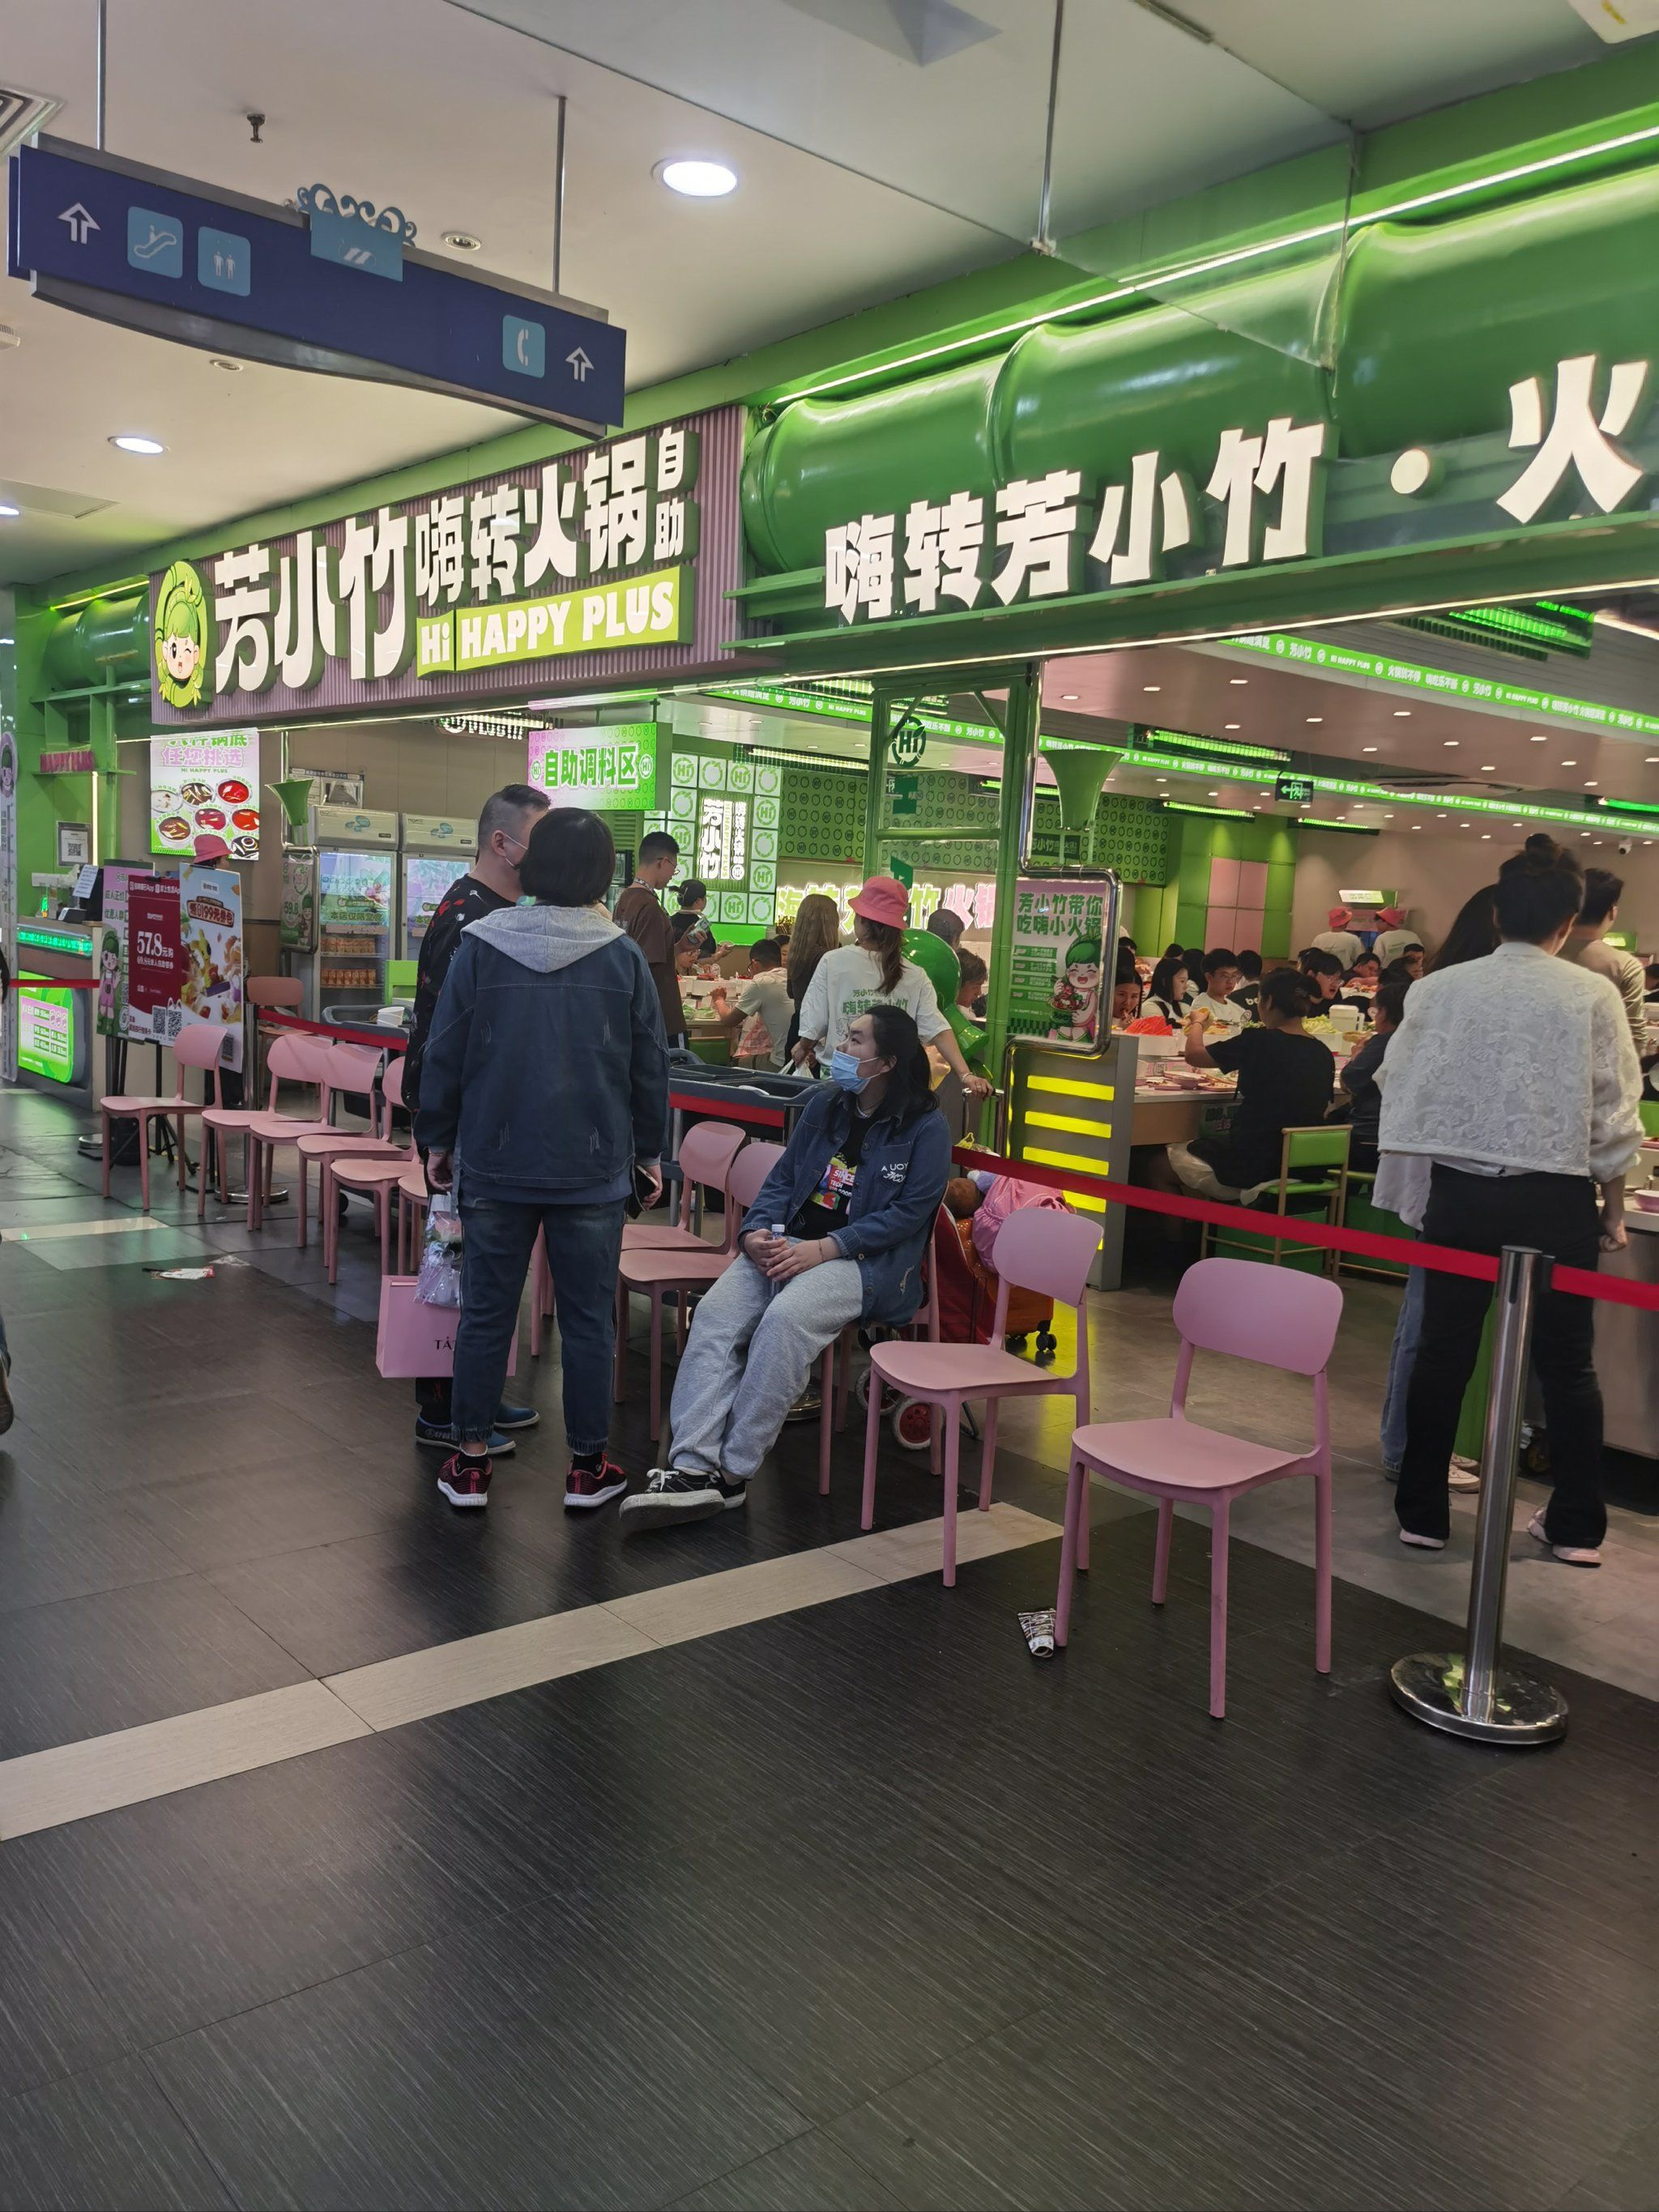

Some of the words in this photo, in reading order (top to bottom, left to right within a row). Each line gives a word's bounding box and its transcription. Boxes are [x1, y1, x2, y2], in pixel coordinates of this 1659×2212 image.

[421, 621, 450, 666] Hi
[461, 600, 572, 660] HAPPY
[582, 581, 674, 642] PLUS
[835, 705, 853, 714] HAPPY
[162, 746, 242, 767] 任您挑选
[544, 744, 638, 789] 自助调料区
[1018, 893, 1103, 916] 芳小竹带你
[1017, 914, 1102, 936] 吃嗨小火锅
